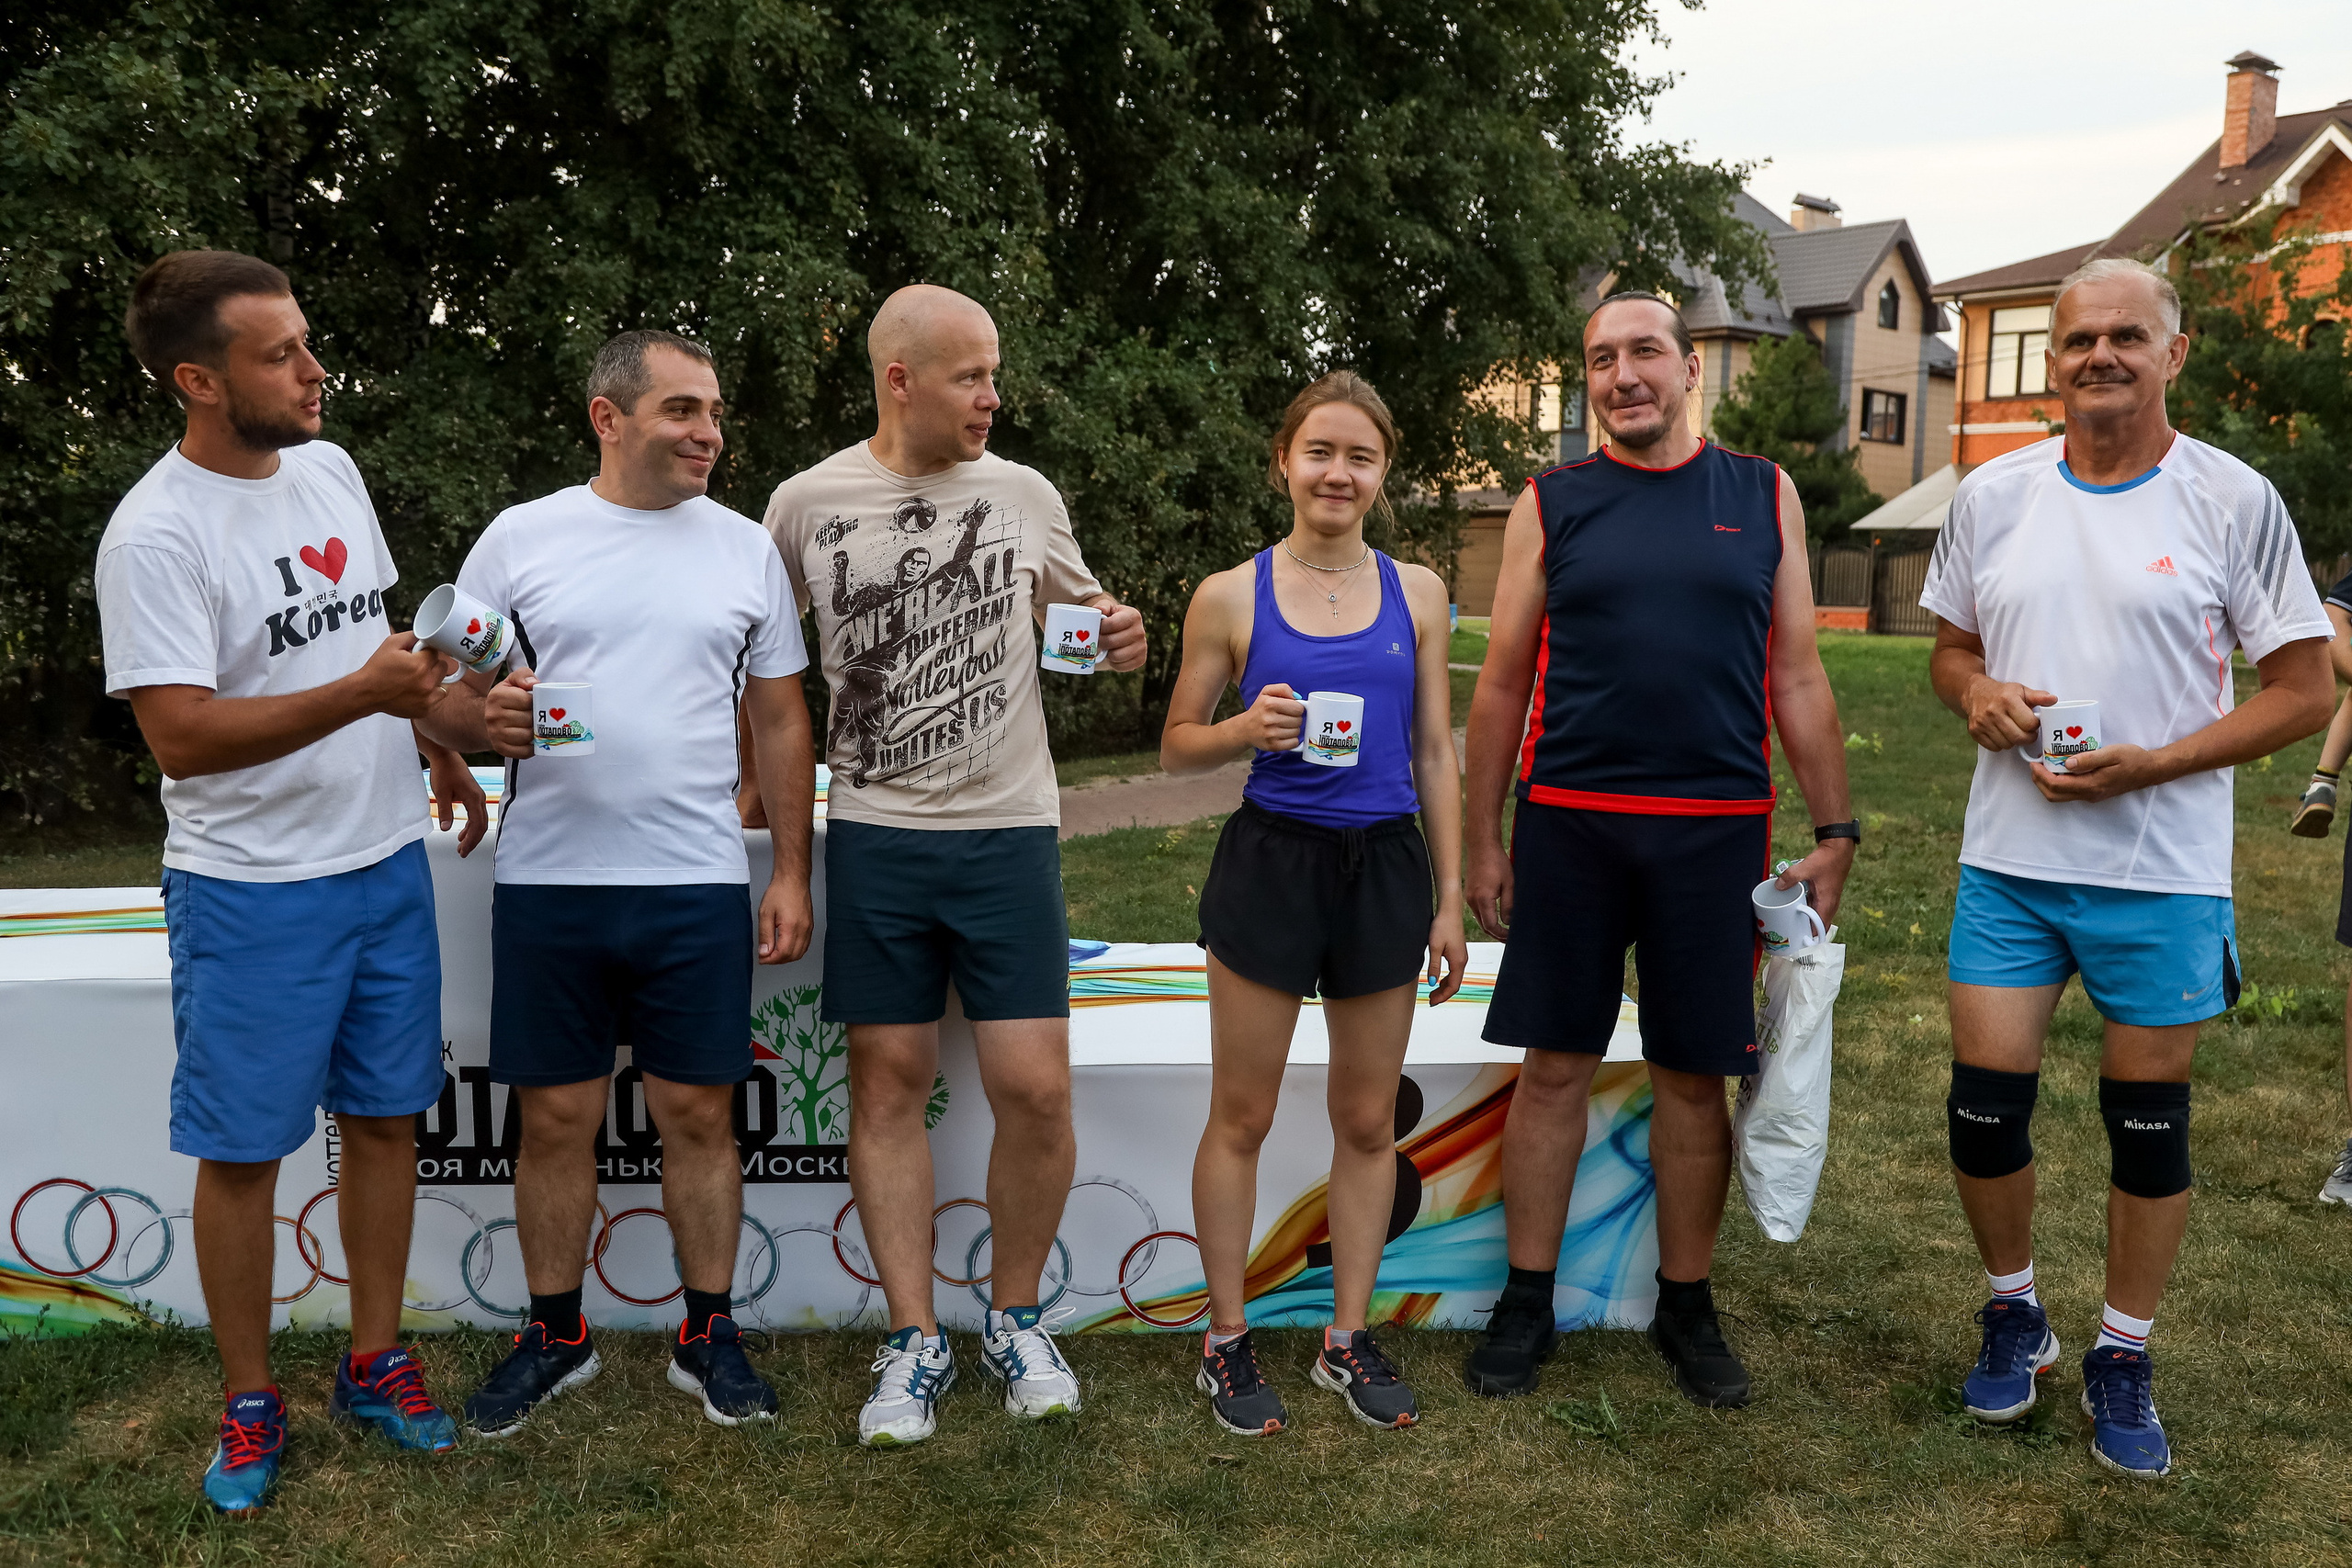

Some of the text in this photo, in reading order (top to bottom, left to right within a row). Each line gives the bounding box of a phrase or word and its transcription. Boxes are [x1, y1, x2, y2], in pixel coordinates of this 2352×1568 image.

[274, 556, 303, 597] I
[2145, 565, 2178, 577] adidas
[949, 547, 1018, 614] ALL
[265, 588, 382, 657] Korea
[905, 591, 1016, 665] DIFFERENT
[459, 636, 476, 650] Я
[1062, 631, 1073, 643] Я
[885, 623, 1009, 720] Volleyball
[538, 710, 547, 723] Я
[969, 683, 1008, 736] US
[1322, 721, 1333, 734] Я
[2052, 729, 2064, 741] Я
[877, 718, 965, 775] UNITES
[2053, 743, 2089, 754] ПОТАПОВО
[245, 1399, 266, 1407] asics
